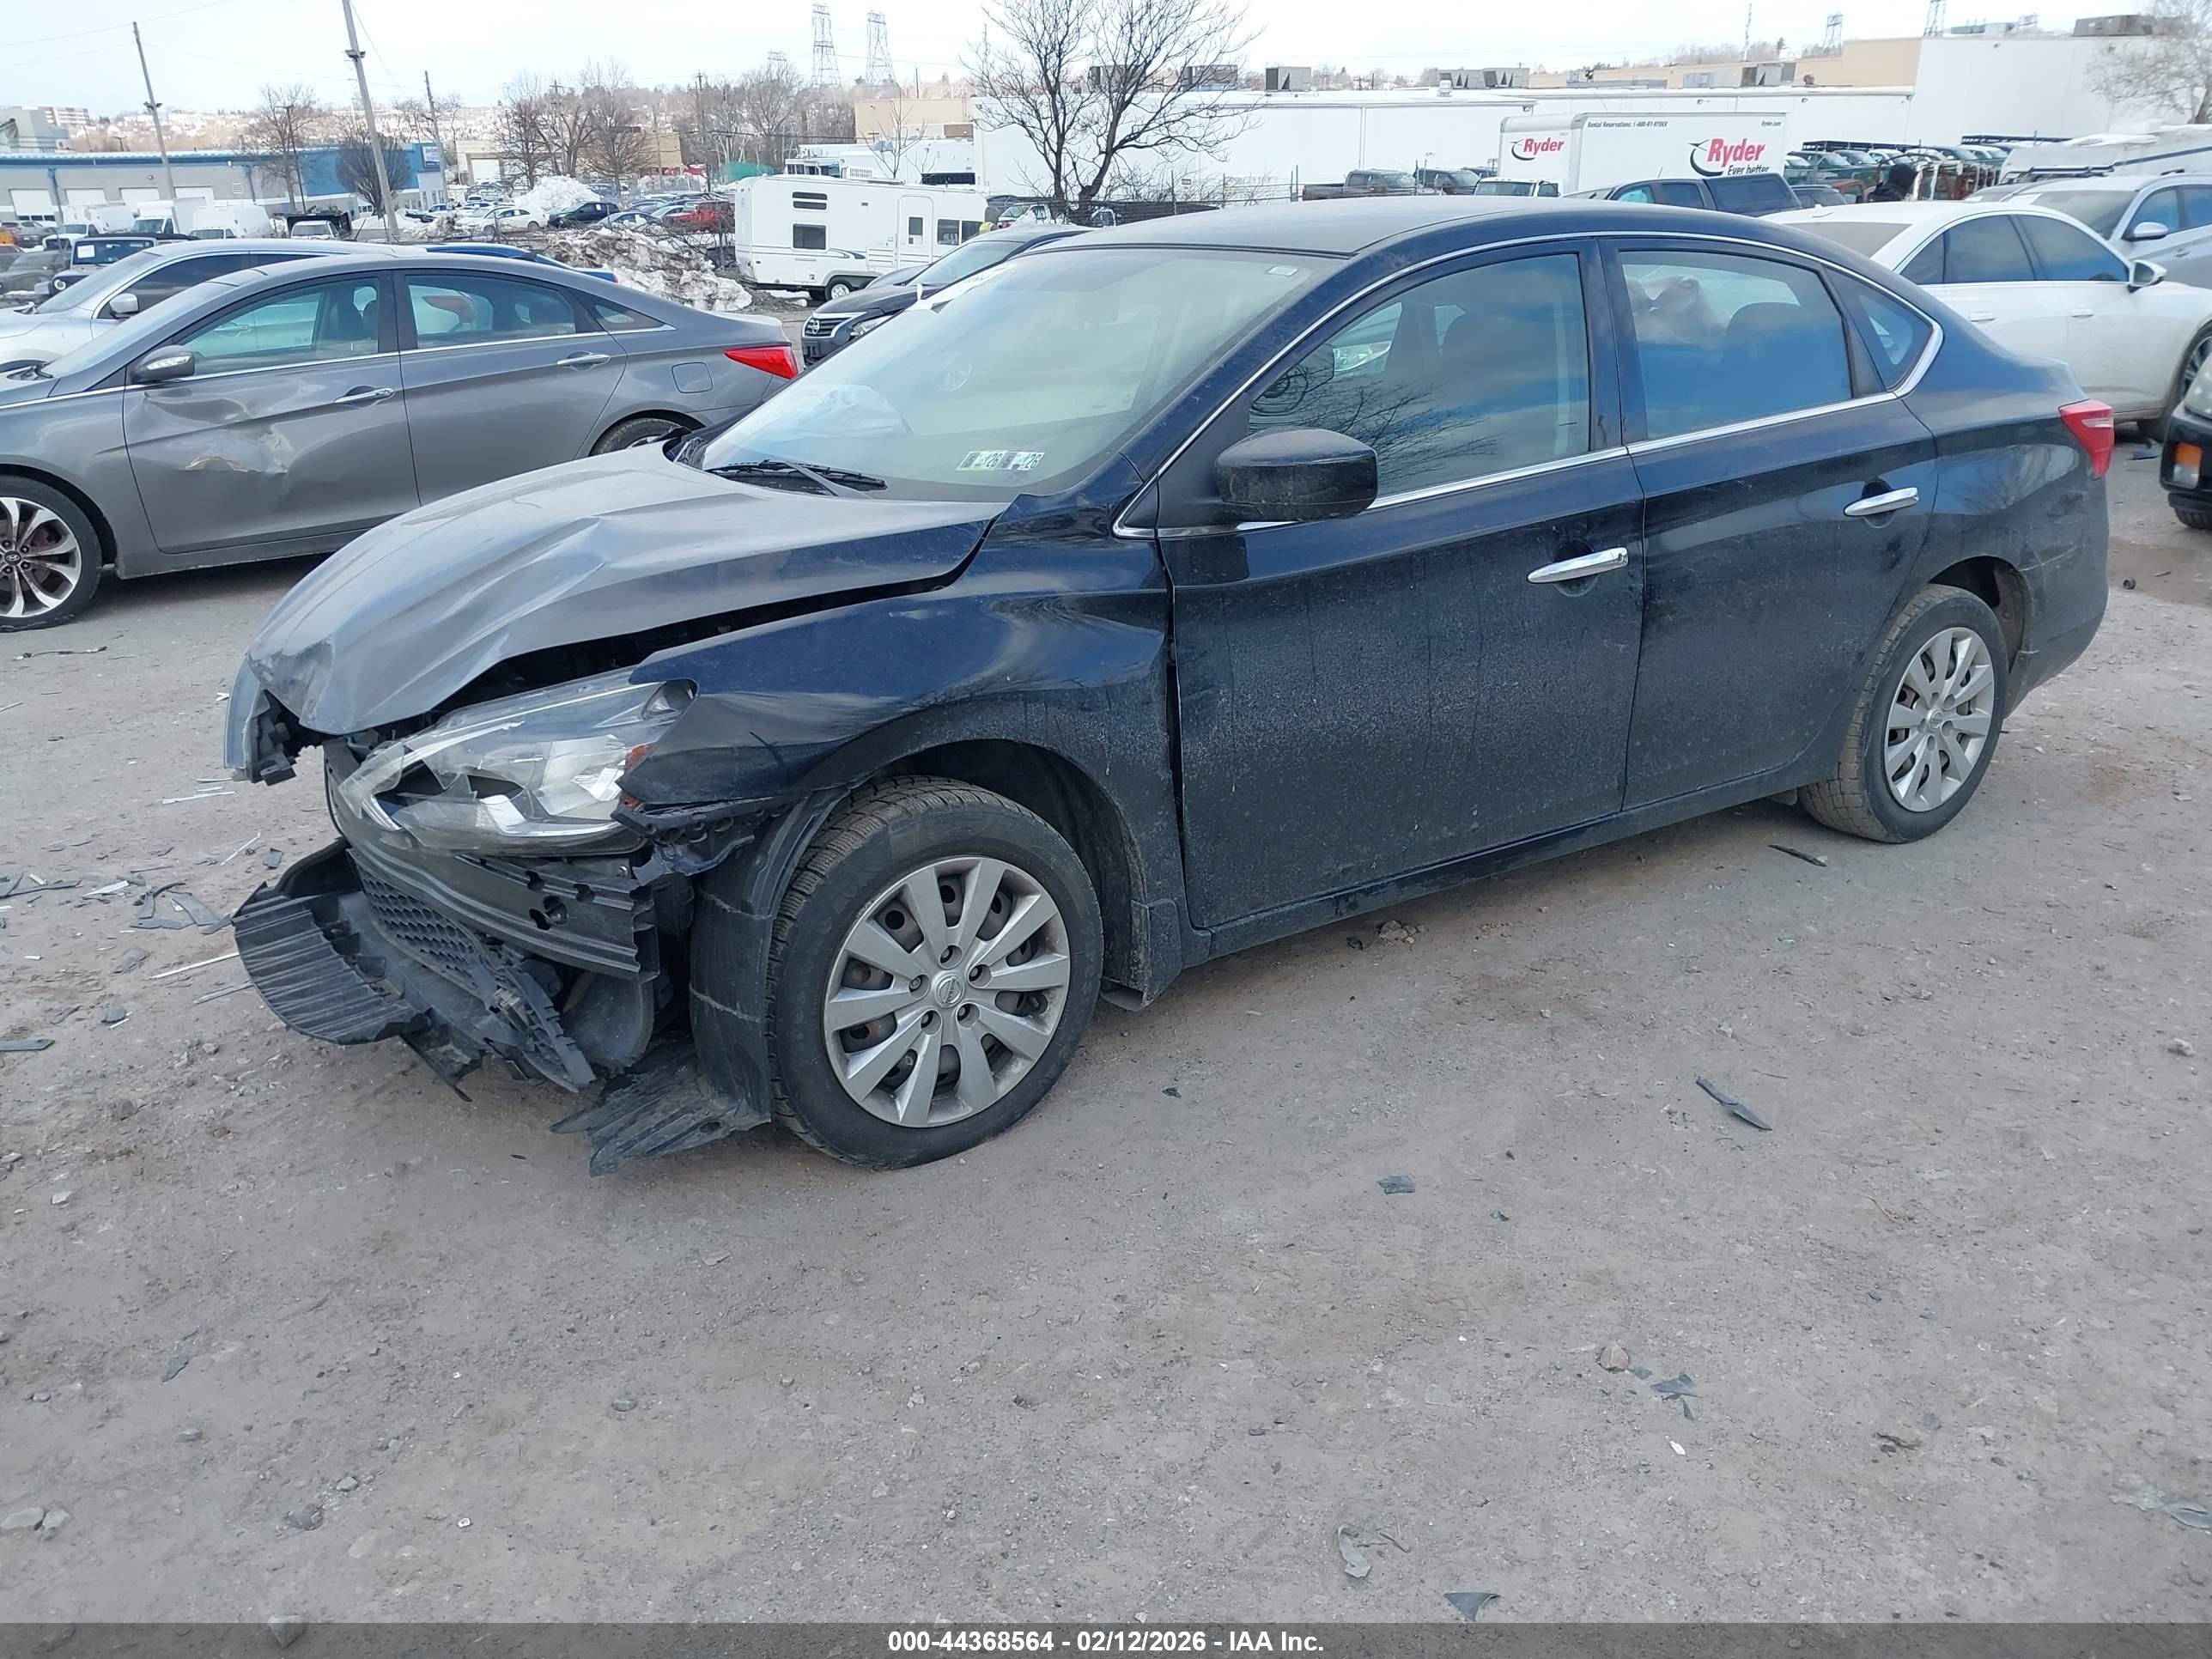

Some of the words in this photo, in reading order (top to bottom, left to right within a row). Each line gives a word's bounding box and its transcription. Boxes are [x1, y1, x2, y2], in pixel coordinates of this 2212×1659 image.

[1522, 137, 1565, 155] Ryder
[1707, 137, 1765, 167] Ryder
[1728, 165, 1744, 176] Ever
[1746, 164, 1770, 174] better
